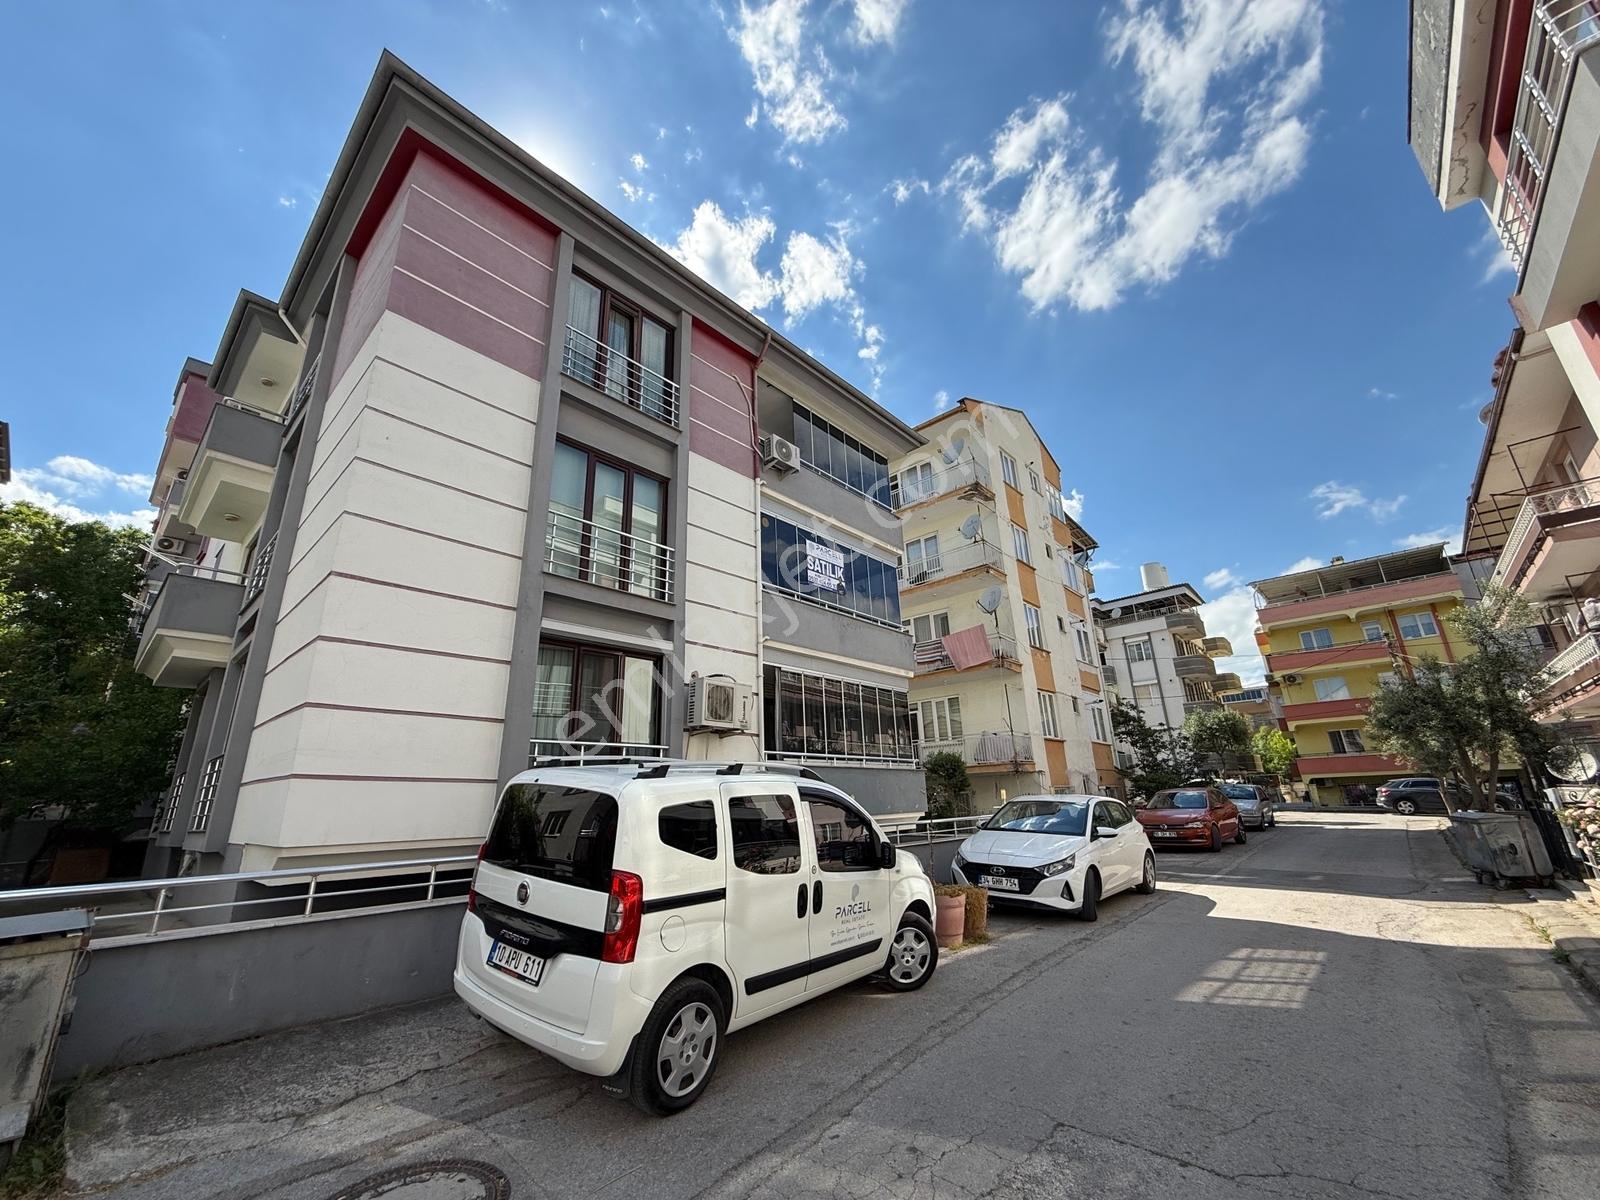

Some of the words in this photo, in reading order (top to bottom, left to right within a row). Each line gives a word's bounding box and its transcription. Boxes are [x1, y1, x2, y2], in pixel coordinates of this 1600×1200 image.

[807, 556, 845, 581] SATILIK
[981, 876, 990, 884] 34
[1005, 879, 1017, 887] 754
[835, 900, 871, 919] PARCELL
[495, 944, 507, 962] 10
[505, 949, 523, 970] APU
[523, 956, 542, 978] 611
